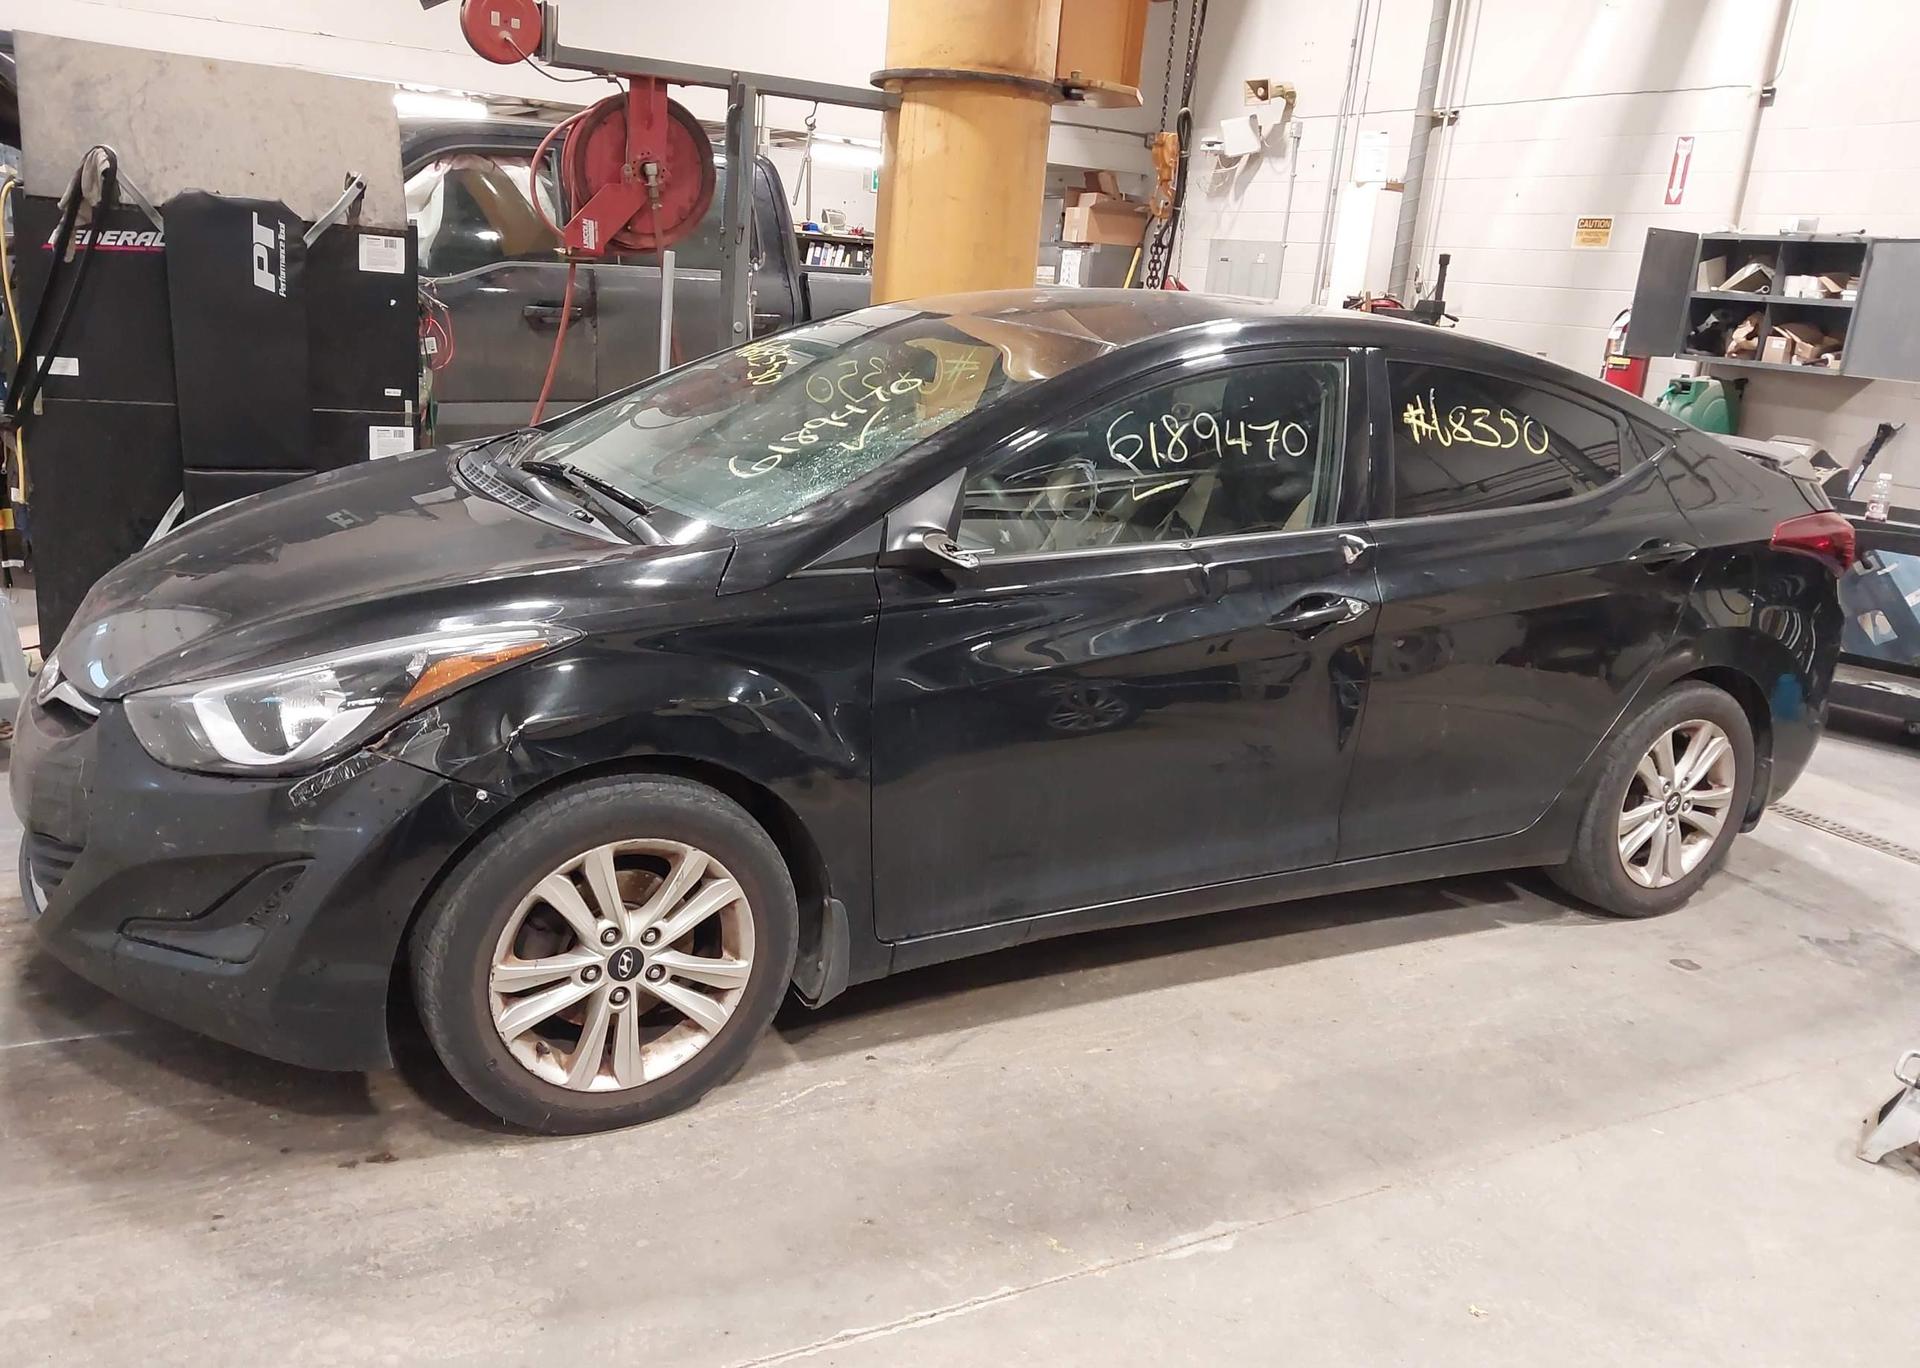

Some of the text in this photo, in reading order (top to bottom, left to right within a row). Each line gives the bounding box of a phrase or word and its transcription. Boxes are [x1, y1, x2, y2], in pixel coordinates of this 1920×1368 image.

[252, 211, 275, 293] PT
[1578, 220, 1610, 228] CAUTION
[1107, 411, 1308, 475] 6189470
